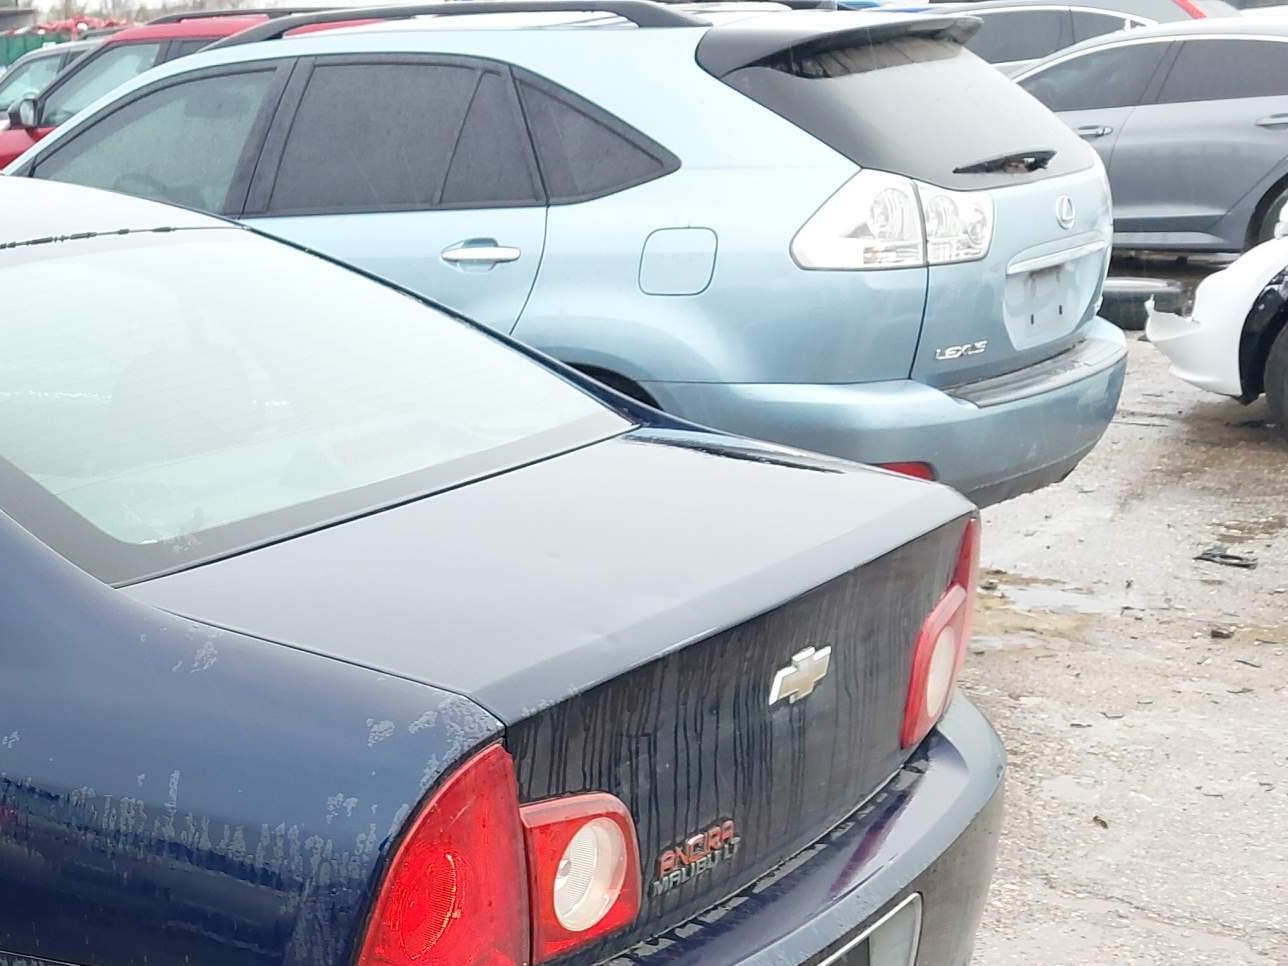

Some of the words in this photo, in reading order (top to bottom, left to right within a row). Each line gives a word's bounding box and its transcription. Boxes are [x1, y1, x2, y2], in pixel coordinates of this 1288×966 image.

[935, 339, 989, 361] LEXUS
[652, 850, 723, 897] MALIBU
[723, 836, 742, 861] LT
